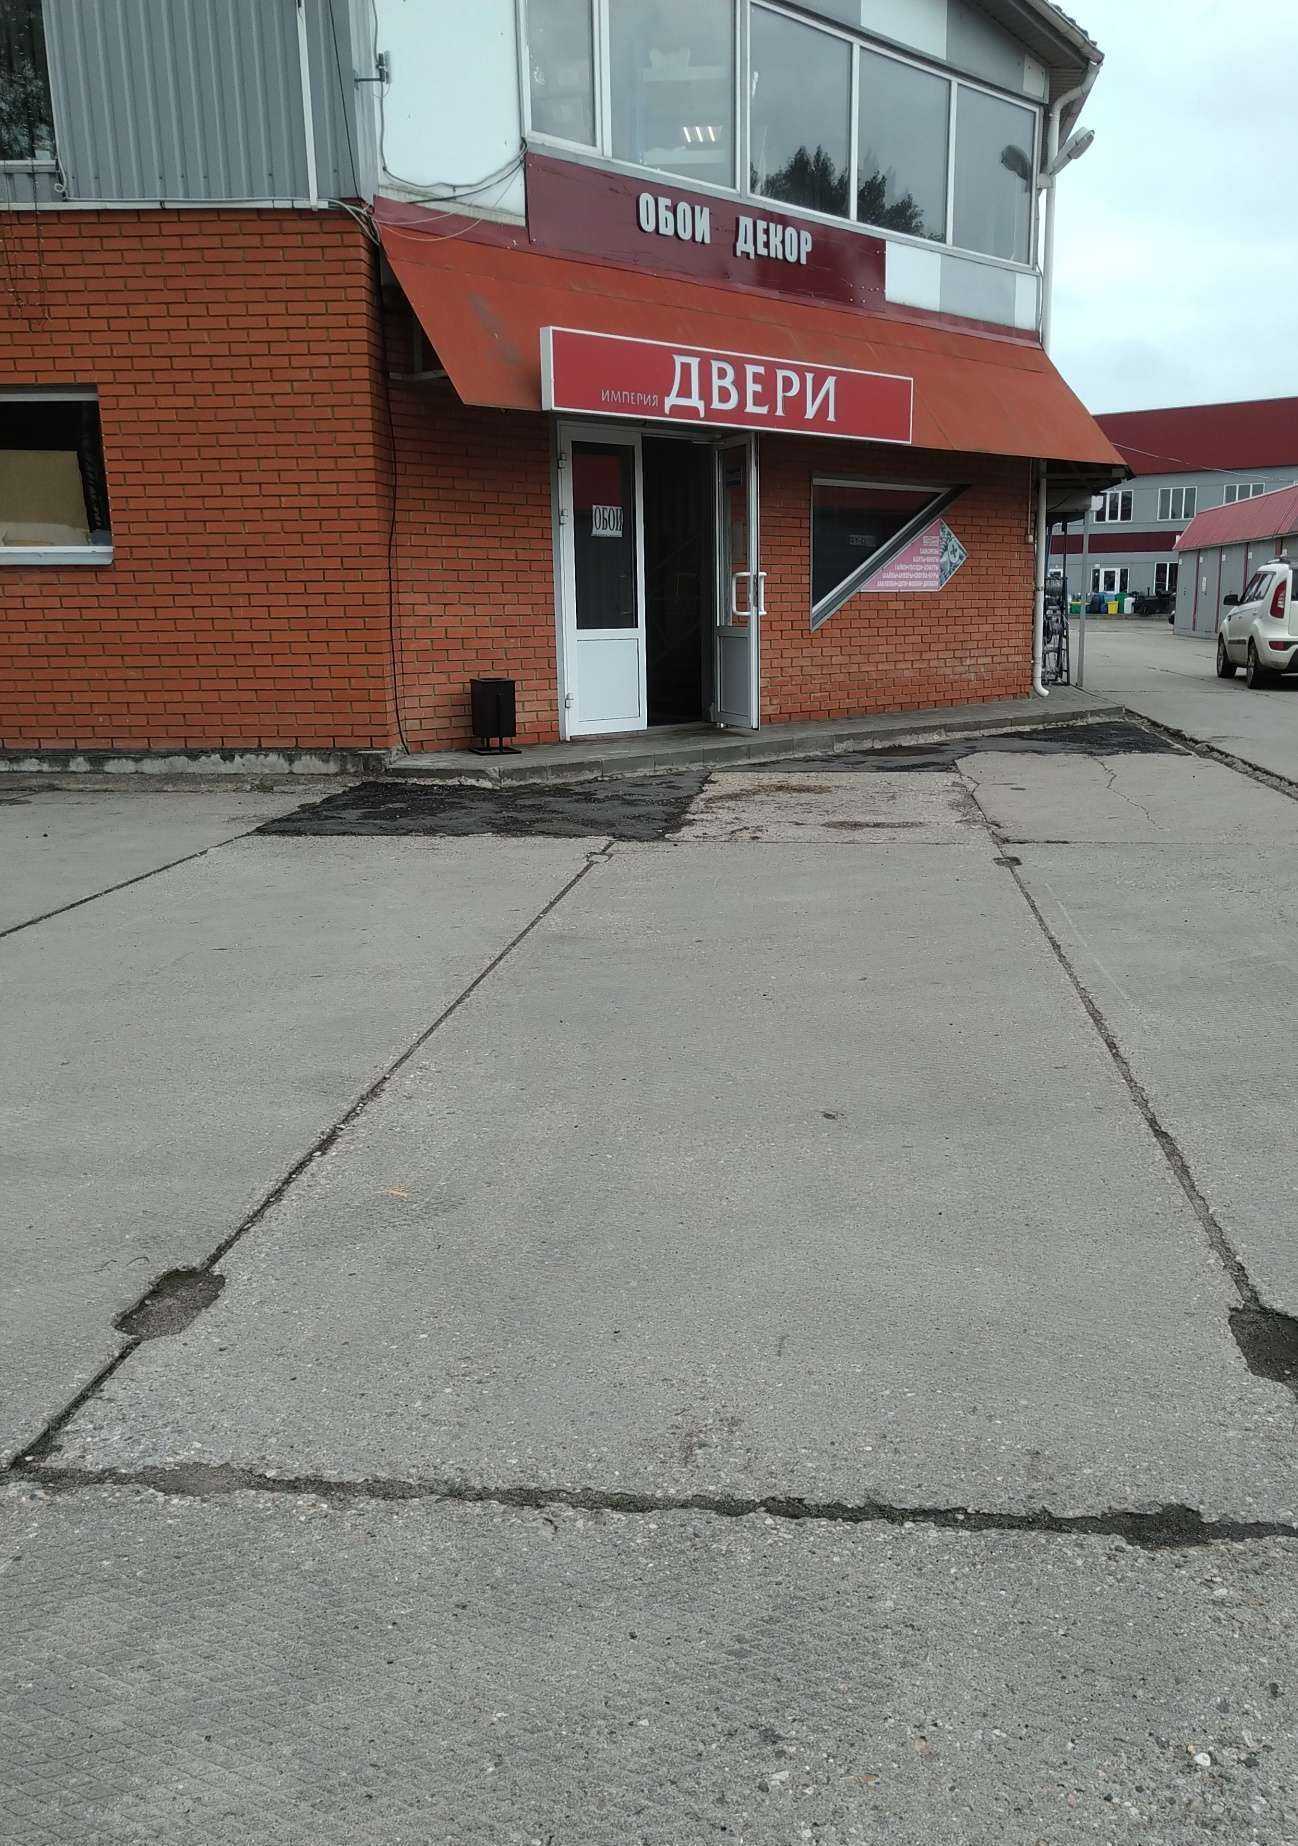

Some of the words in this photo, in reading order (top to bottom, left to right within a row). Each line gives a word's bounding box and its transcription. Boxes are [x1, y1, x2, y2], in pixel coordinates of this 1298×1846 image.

[637, 192, 711, 245] ОБОИ
[735, 216, 813, 265] ДЕКОР
[601, 388, 659, 408] ИМПЕРИЯ
[664, 354, 838, 423] ДВЕРИ
[594, 506, 624, 532] ОБОИ
